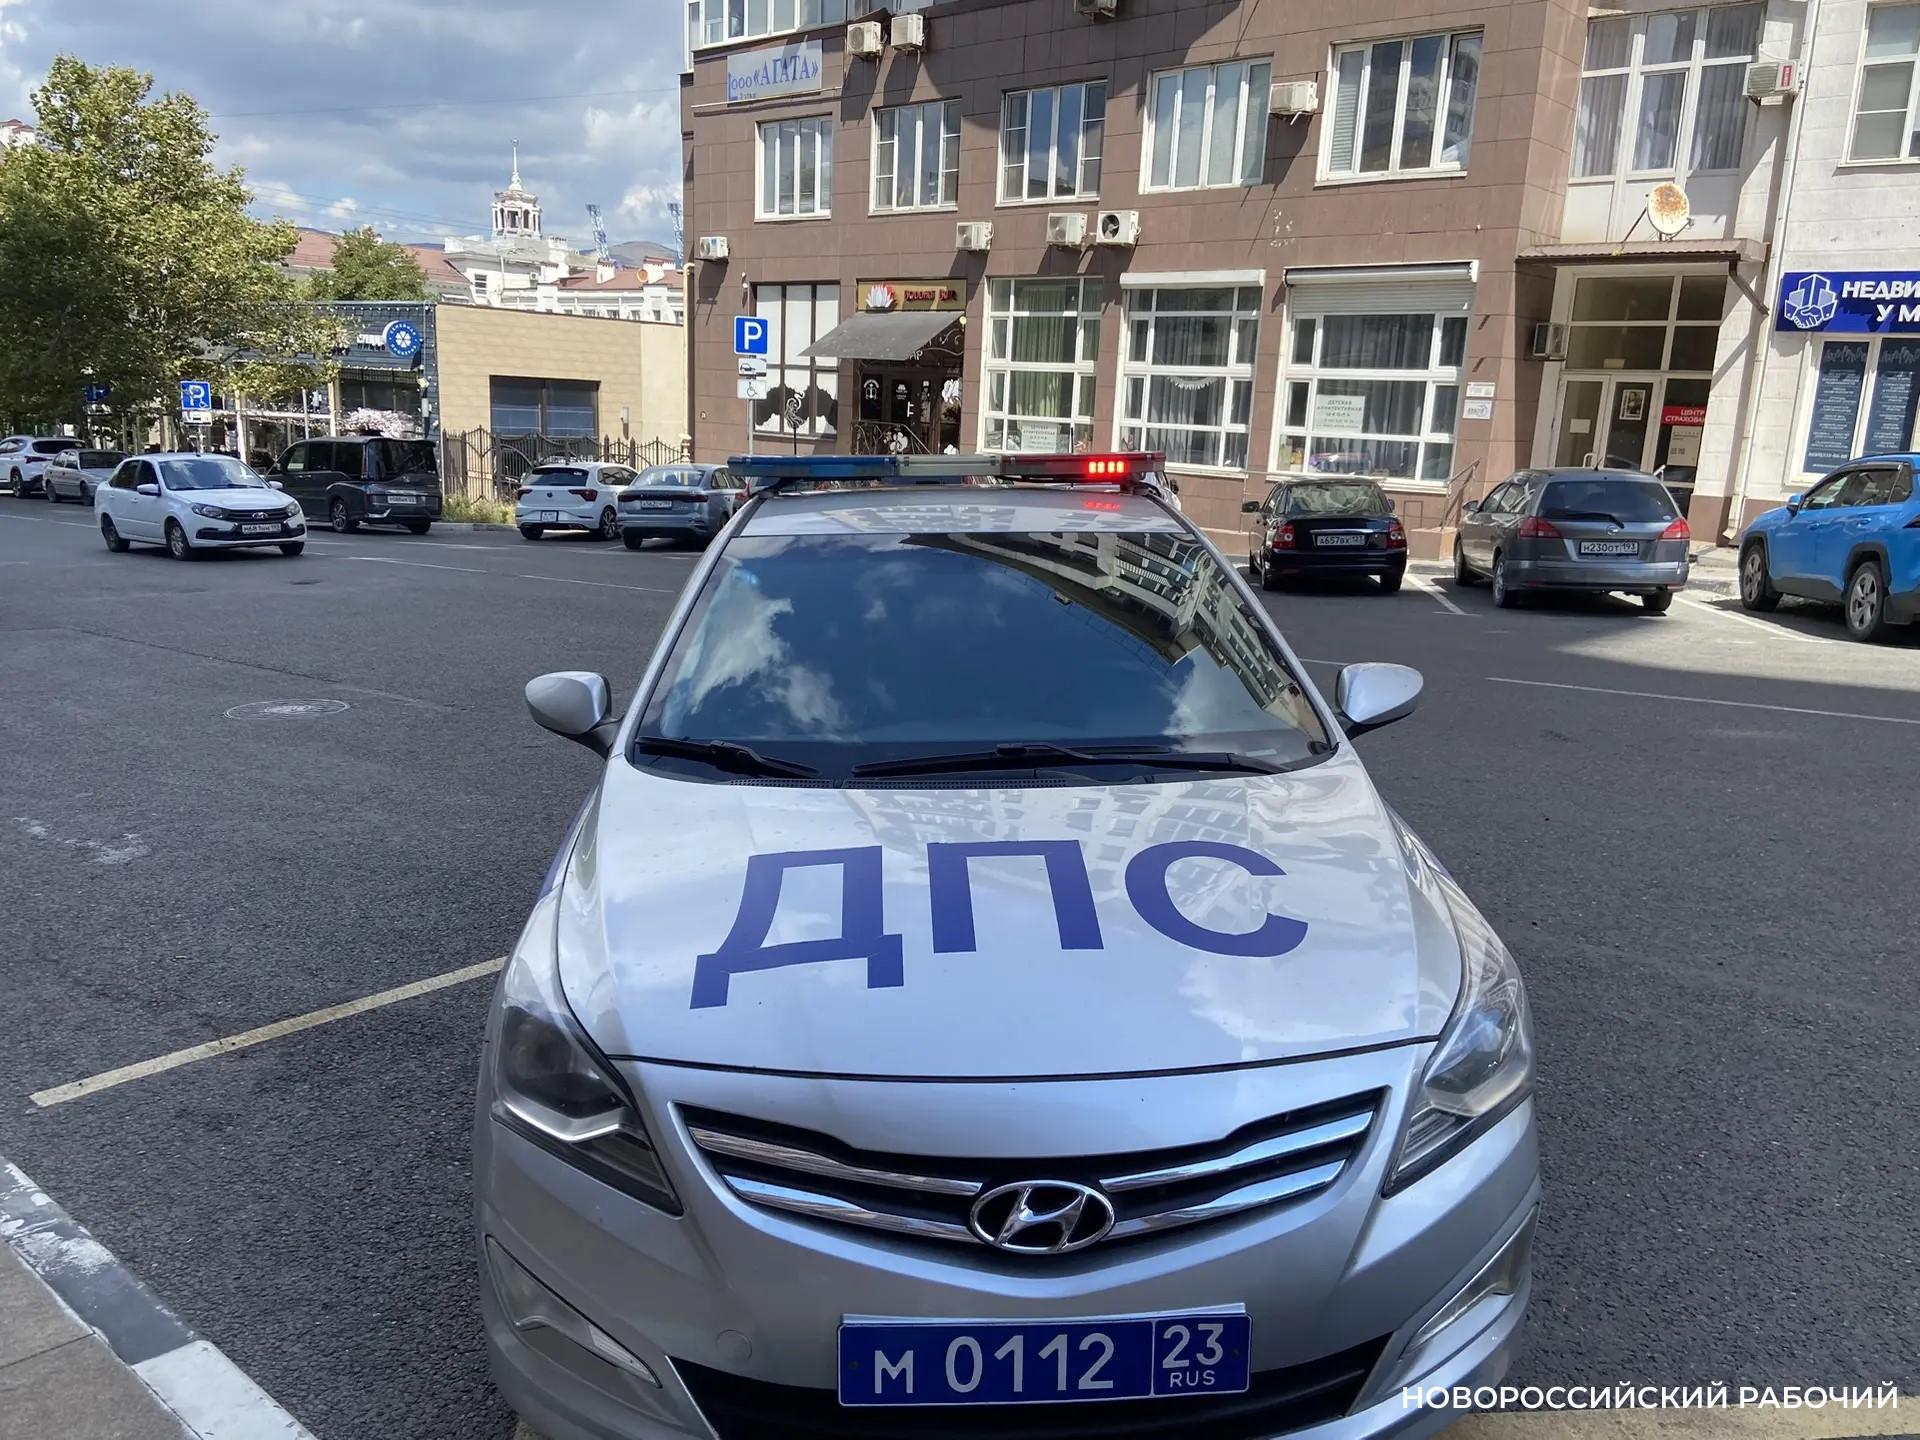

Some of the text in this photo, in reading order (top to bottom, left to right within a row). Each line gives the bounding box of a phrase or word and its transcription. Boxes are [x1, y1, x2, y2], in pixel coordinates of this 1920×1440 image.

[753, 55, 819, 87] «АГАТА»
[1841, 281, 1920, 300] НЕДВИ
[1876, 304, 1894, 322] У
[744, 321, 763, 350] P
[1664, 415, 1705, 423] СТРАХОВА
[690, 840, 1309, 1009] ДПС
[873, 1323, 1224, 1394] М 0112 23
[1169, 1369, 1216, 1388] RUS
